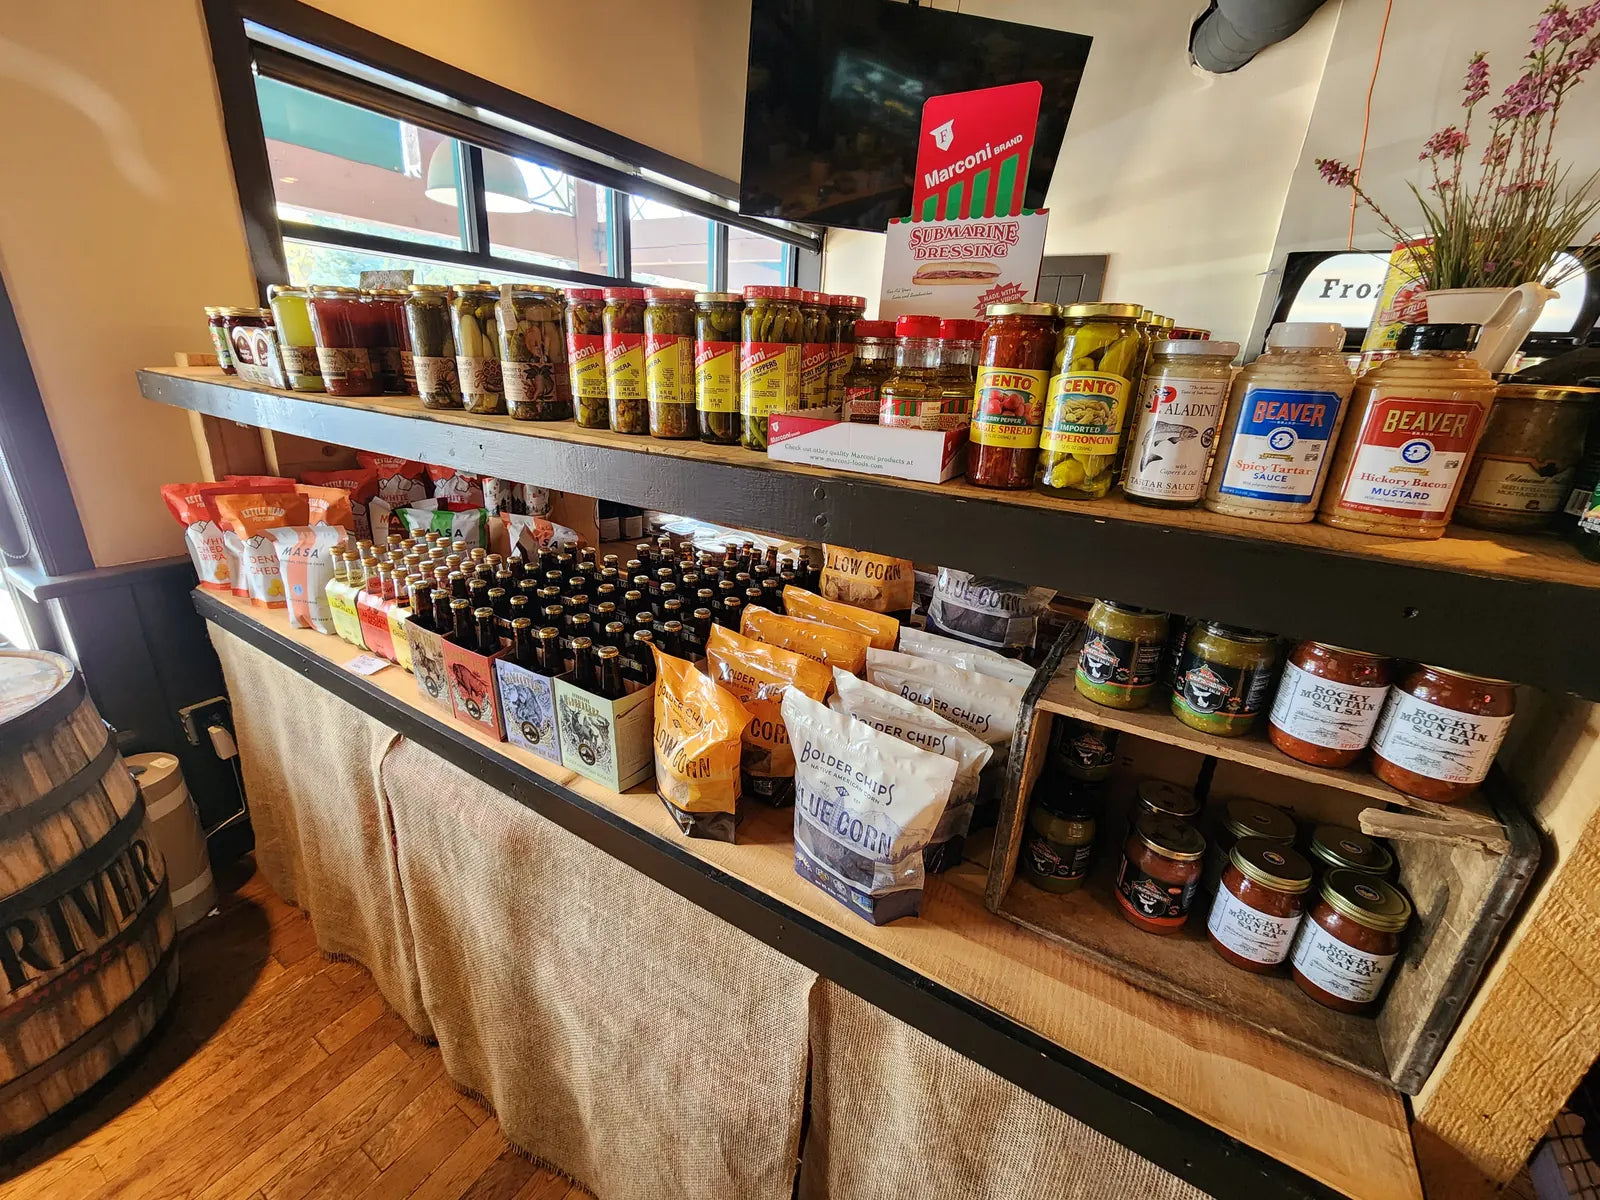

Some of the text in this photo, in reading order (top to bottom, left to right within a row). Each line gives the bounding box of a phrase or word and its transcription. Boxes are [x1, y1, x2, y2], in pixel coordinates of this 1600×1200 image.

[924, 134, 1023, 189] Marconi BRAND
[910, 222, 1019, 248] SUBMARINE
[914, 244, 1007, 260] DRESSING
[983, 287, 1017, 302] MADE WITH
[1000, 293, 1021, 304] VIRGIN
[753, 360, 778, 374] PEPPERS
[1063, 379, 1117, 395] CENTO
[1000, 416, 1022, 424] PEPPER
[1253, 401, 1326, 428] BEAVER
[1382, 409, 1469, 439] BEAVER
[770, 431, 791, 443] Marconi
[999, 425, 1033, 435] SPREAD
[1060, 424, 1101, 433] IMPORTED
[785, 443, 801, 452] Check
[812, 447, 828, 455] other
[829, 448, 849, 458] quality
[850, 452, 876, 461] Marconi
[877, 455, 905, 465] products
[809, 455, 884, 470] www.marconi-foods.com
[1236, 459, 1313, 476] Spicy Tartar
[1166, 482, 1196, 491] SAUCE
[1253, 472, 1288, 483] SAUCE
[1360, 472, 1447, 489] Hickory Bacon
[184, 494, 202, 505] KETT
[1371, 487, 1430, 500] MUSTARD
[198, 546, 224, 555] CHED
[200, 537, 224, 547] WHI
[541, 537, 559, 549] SA
[201, 553, 227, 562] SRIRA
[250, 554, 280, 565] DENV
[282, 546, 319, 559] MASA
[249, 566, 280, 576] CHED
[826, 553, 901, 581] LLOW CORN
[1300, 689, 1377, 711] MOUNTAIN
[1314, 684, 1371, 703] ROCKY
[900, 685, 992, 734] BOLDER CHIPS
[1312, 700, 1362, 717] SALSA
[1400, 712, 1489, 743] MOUNTAIN
[1415, 707, 1480, 732] ROCKY
[751, 717, 786, 744] COR
[1412, 724, 1471, 747] SALSA
[655, 722, 711, 778] LOW CORN
[906, 730, 948, 755] CHIPS
[800, 740, 895, 806] BOLDER CHIPS
[810, 763, 881, 805] NATIVE AMERICAN CORN
[836, 810, 892, 858] CORN
[0, 839, 162, 995] RIVER
[1228, 909, 1289, 936] MOUNTAIN
[1236, 908, 1285, 930] ROCKY
[1237, 920, 1278, 939] SALSA
[1316, 942, 1384, 974] MOUNTAIN
[1328, 941, 1378, 967] ROCKY
[1327, 955, 1372, 978] SALSA
